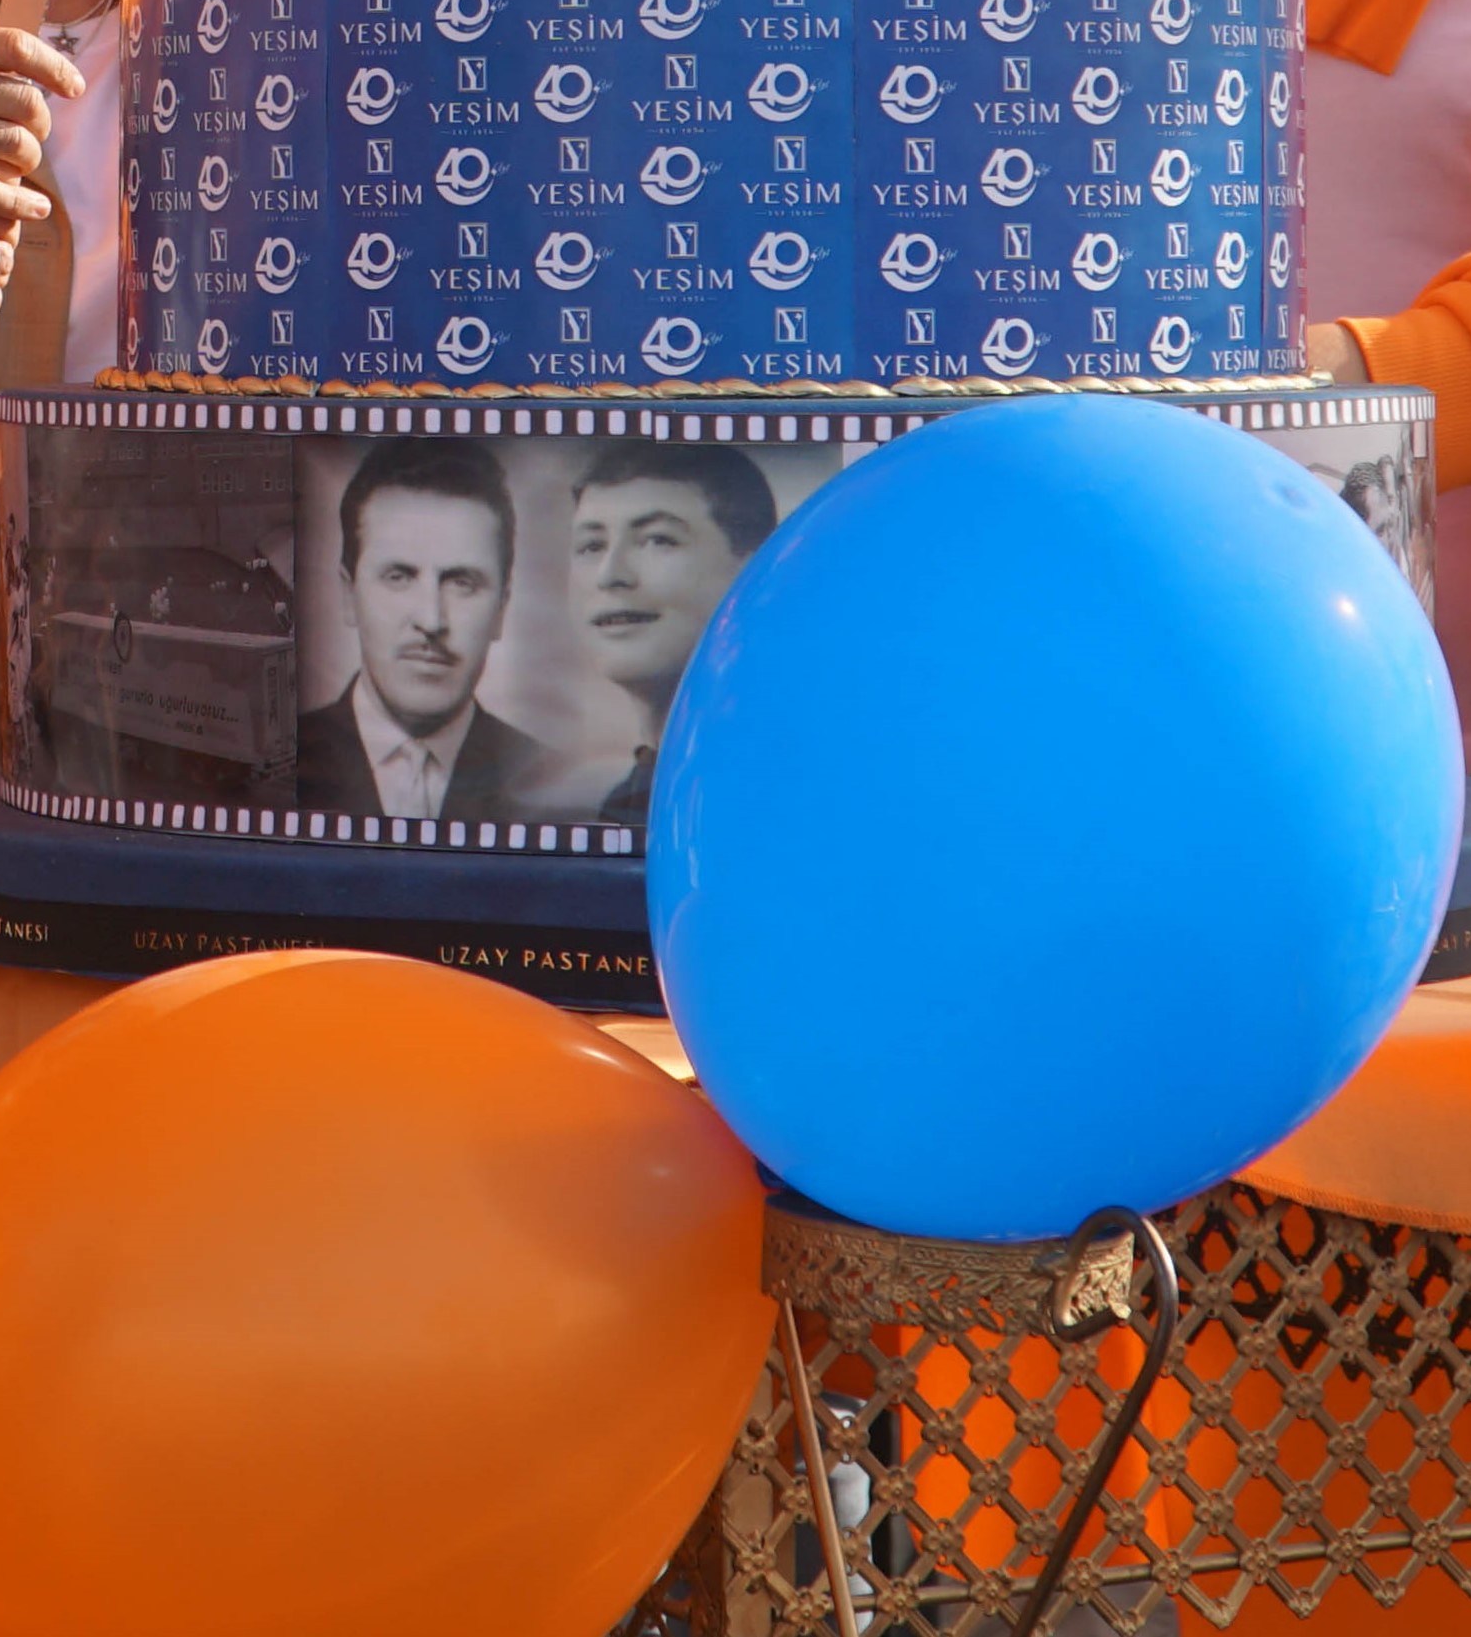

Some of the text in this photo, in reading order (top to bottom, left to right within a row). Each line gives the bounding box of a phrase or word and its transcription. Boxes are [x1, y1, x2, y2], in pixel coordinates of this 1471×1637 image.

[250, 24, 318, 53] YEŞİM
[339, 16, 422, 46] YEŞİM
[527, 14, 624, 42] YEŞİM
[740, 12, 841, 42] YEŞİM
[872, 14, 967, 43] YEŞİM
[1065, 17, 1141, 45] YEŞİM
[1211, 20, 1257, 46] YEŞİM
[256, 75, 294, 115] 40
[347, 68, 395, 110] 40
[534, 65, 593, 108] 40
[749, 63, 809, 107] 40
[880, 65, 937, 108] 40
[1073, 67, 1120, 109] 40
[1216, 69, 1245, 110] 40
[193, 110, 246, 133] YEŞİM
[428, 97, 520, 126] YEŞİM
[631, 95, 733, 124] YEŞİM
[973, 97, 1060, 126] YEŞİM
[1146, 100, 1208, 126] YEŞİM
[199, 156, 228, 195] 40
[436, 147, 491, 190] 40
[640, 146, 702, 190] 40
[980, 148, 1034, 191] 40
[1151, 148, 1191, 191] 40
[250, 185, 319, 212] YEŞİM
[341, 179, 423, 207] YEŞİM
[527, 178, 625, 207] YEŞİM
[741, 178, 841, 207] YEŞİM
[872, 179, 968, 208] YEŞİM
[1065, 180, 1142, 208] YEŞİM
[1210, 180, 1259, 206] YEŞİM
[256, 237, 296, 278] 40
[348, 233, 396, 274] 40
[535, 232, 594, 274] 40
[750, 232, 810, 274] 40
[881, 233, 938, 275] 40
[1073, 233, 1121, 275] 40
[1216, 232, 1246, 274] 40
[194, 267, 247, 292] YEŞİM
[429, 264, 521, 292] YEŞİM
[632, 264, 734, 292] YEŞİM
[974, 265, 1060, 294] YEŞİM
[1145, 267, 1209, 292] YEŞİM
[199, 319, 228, 359] 40
[436, 316, 491, 359] 40
[641, 317, 703, 360] 40
[982, 318, 1035, 361] 40
[1150, 316, 1192, 358] 40
[250, 354, 318, 376] YEŞİM
[341, 349, 423, 376] YEŞİM
[528, 348, 626, 376] YEŞİM
[741, 349, 842, 378] YEŞİM
[873, 350, 968, 376] YEŞİM
[1065, 348, 1141, 376] YEŞİM
[135, 931, 186, 950] UZAY
[440, 945, 652, 976] UZAY PASTANE
